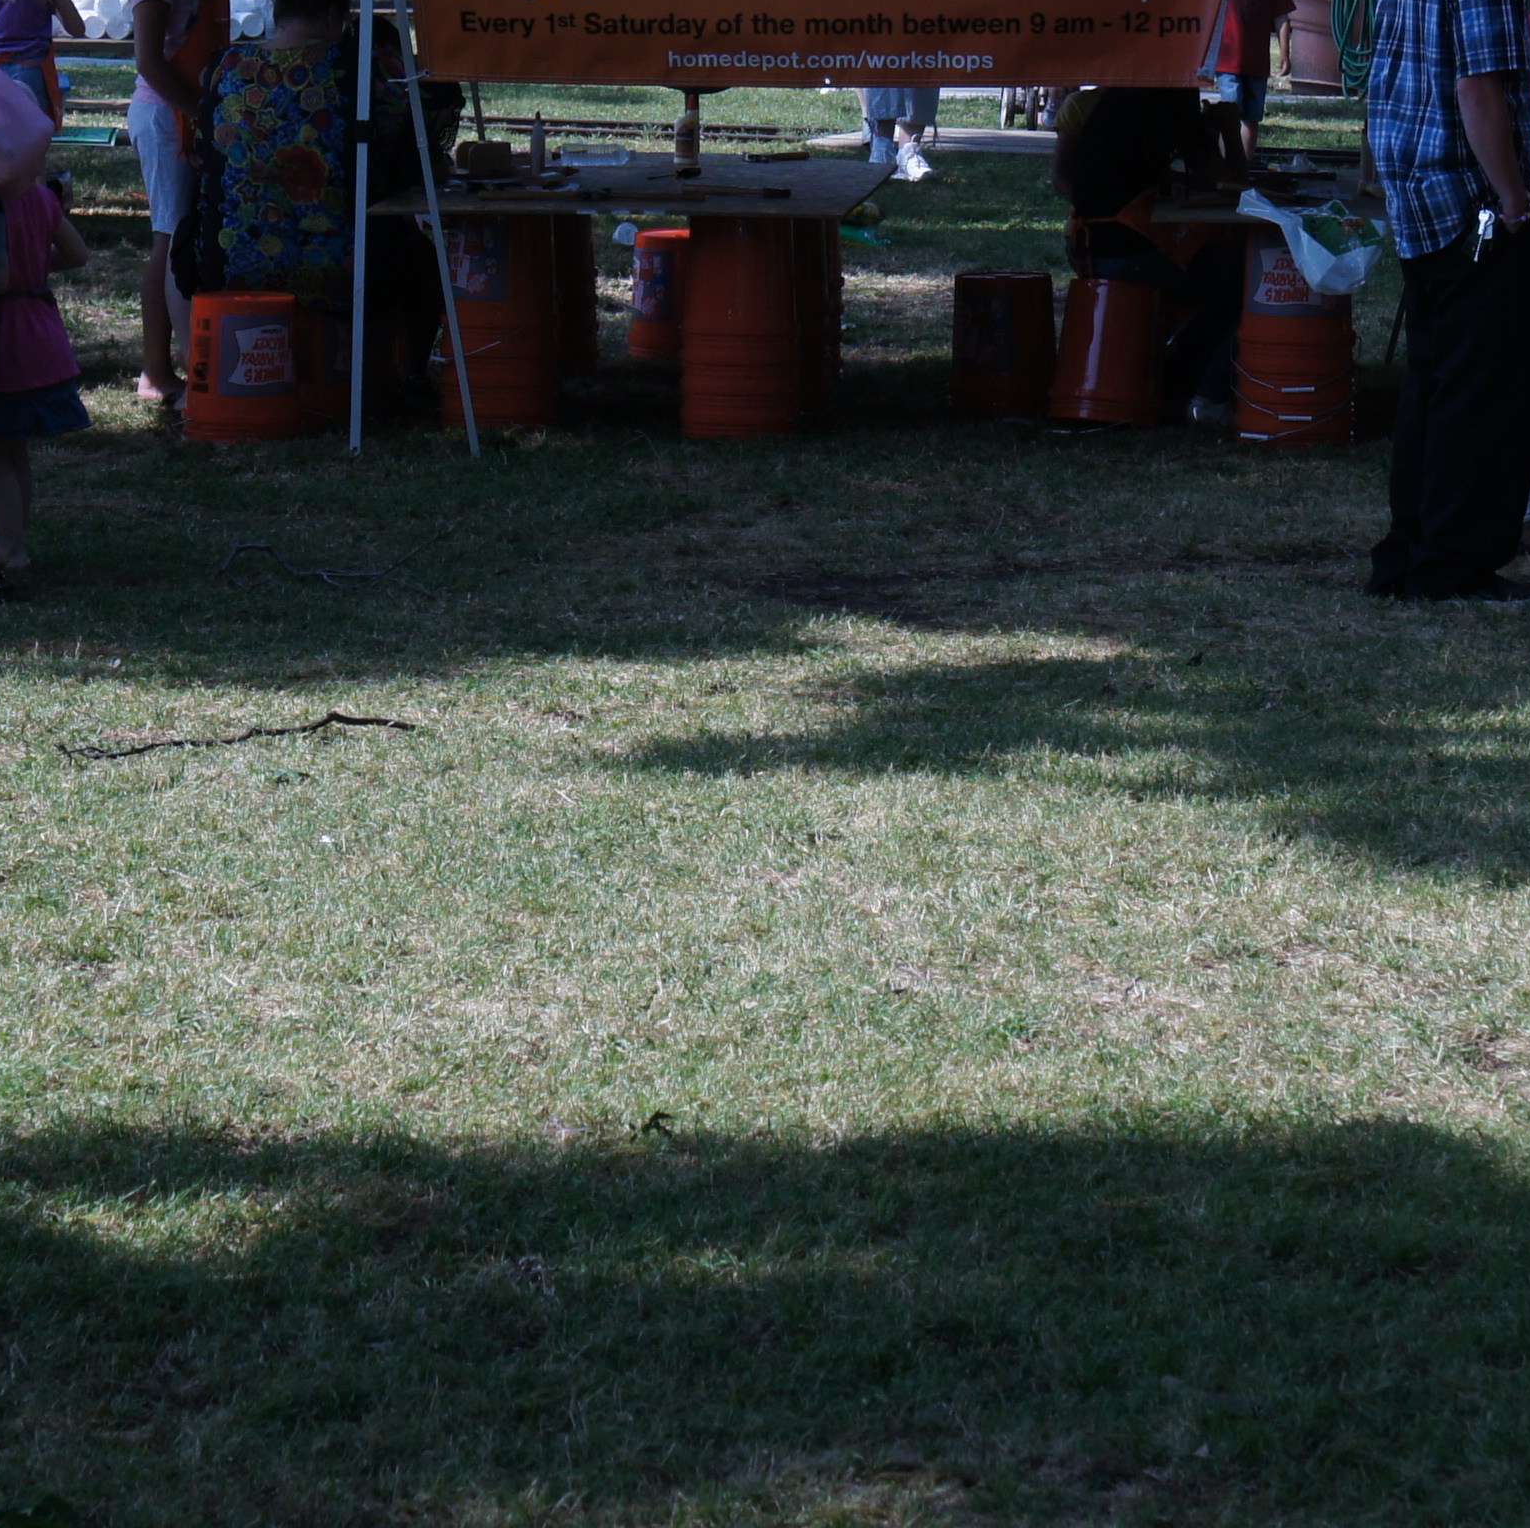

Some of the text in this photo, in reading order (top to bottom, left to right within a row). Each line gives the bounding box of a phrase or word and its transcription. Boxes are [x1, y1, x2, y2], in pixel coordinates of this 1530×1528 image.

[460, 11, 535, 38] Every
[584, 12, 707, 40] Saturday
[715, 12, 743, 35] of
[752, 12, 796, 35] the
[805, 13, 893, 35] month
[902, 12, 1021, 35] between
[1030, 12, 1046, 35] 9
[1053, 17, 1095, 34] am
[1120, 11, 1151, 34] 12
[1158, 16, 1202, 38] pm
[668, 50, 995, 73] homedepot.com/workshops
